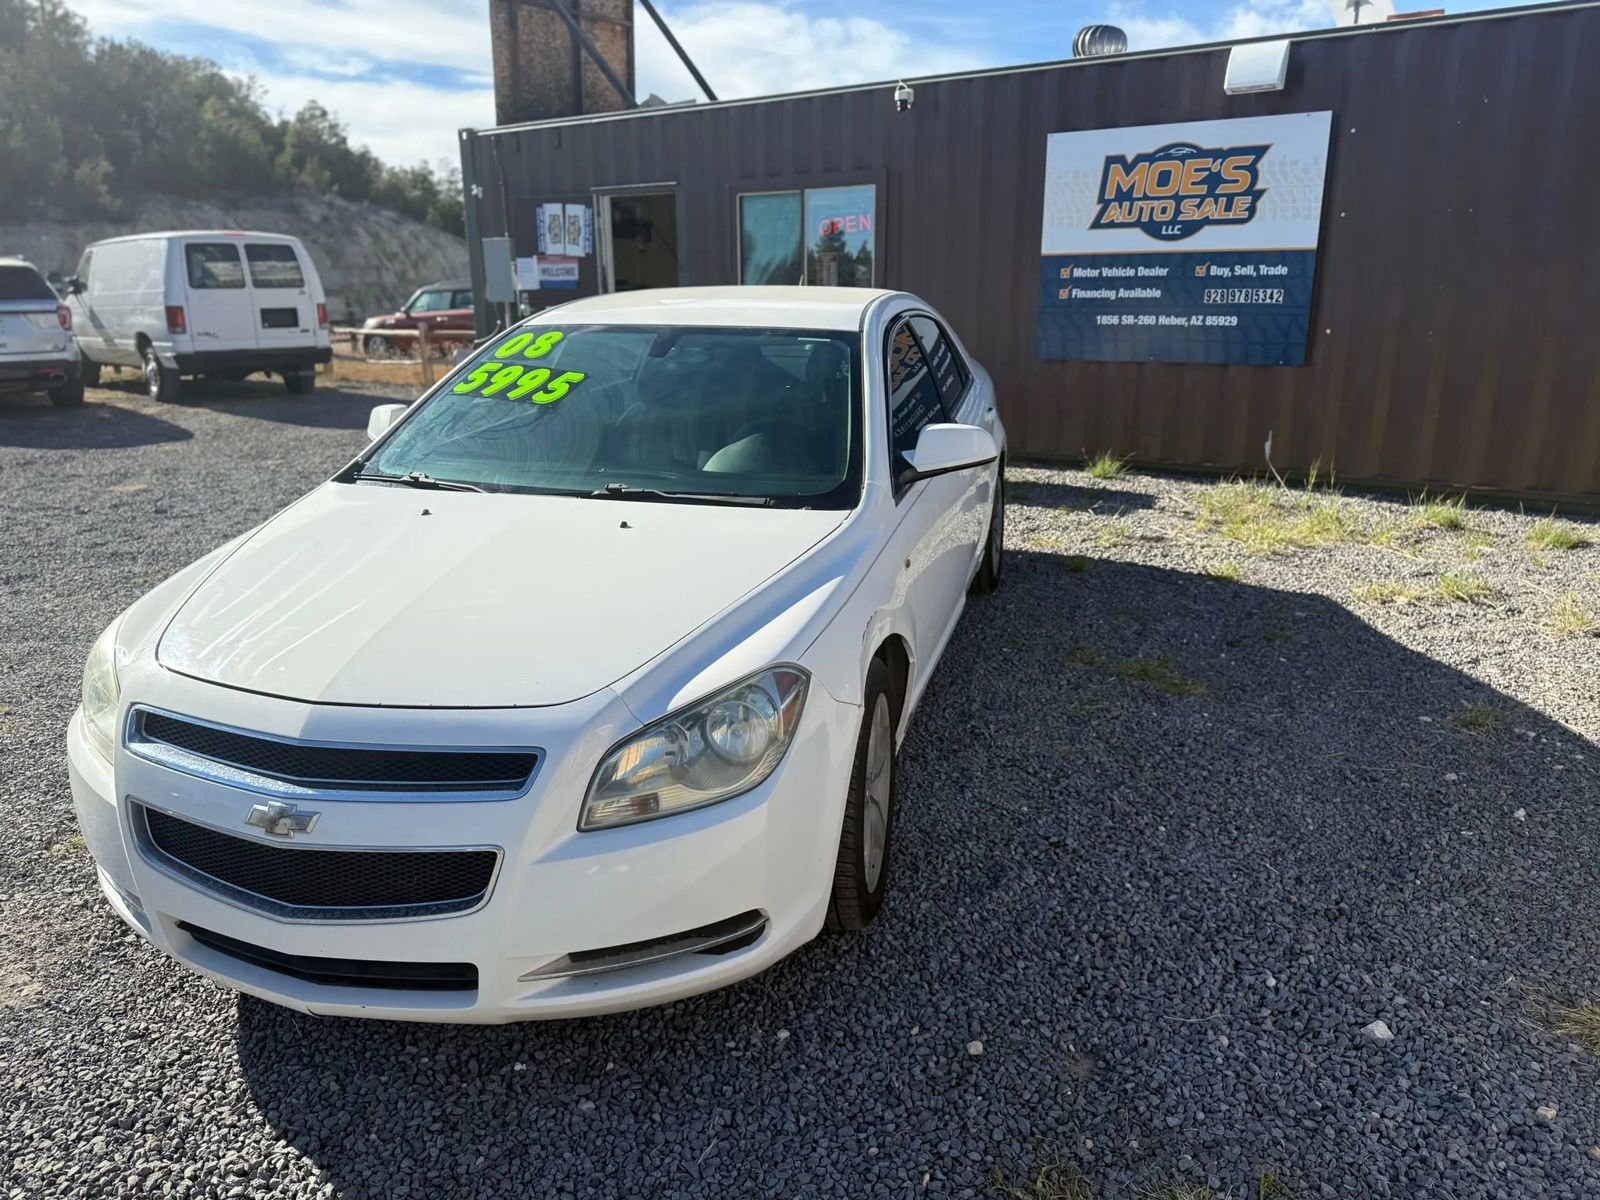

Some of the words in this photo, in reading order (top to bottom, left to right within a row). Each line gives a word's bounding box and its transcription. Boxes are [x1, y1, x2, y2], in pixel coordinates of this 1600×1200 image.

[1105, 155, 1256, 199] MOE'S
[1101, 200, 1175, 223] AUTO
[1177, 196, 1252, 221] SALE
[819, 214, 873, 236] OPEN
[1161, 225, 1182, 235] LLC
[541, 266, 576, 277] WELCOME
[1073, 267, 1100, 278] Motor
[1101, 267, 1136, 277] Vehicle
[1137, 266, 1169, 277] Dealer
[1210, 265, 1233, 277] Buy,
[1234, 265, 1257, 277] Sell,
[1259, 265, 1288, 276] Trade
[1072, 288, 1116, 300] Financing
[1117, 288, 1162, 299] Available
[1205, 290, 1226, 303] 928
[1230, 290, 1251, 303] 978
[1254, 290, 1283, 304] 5342
[1096, 315, 1119, 325] 1856
[1121, 315, 1157, 326] SR-260
[1158, 315, 1189, 327] Heber,
[1190, 315, 1204, 326] AZ
[1205, 316, 1238, 327] 85929
[494, 331, 564, 358] 08
[452, 362, 585, 404] 5995
